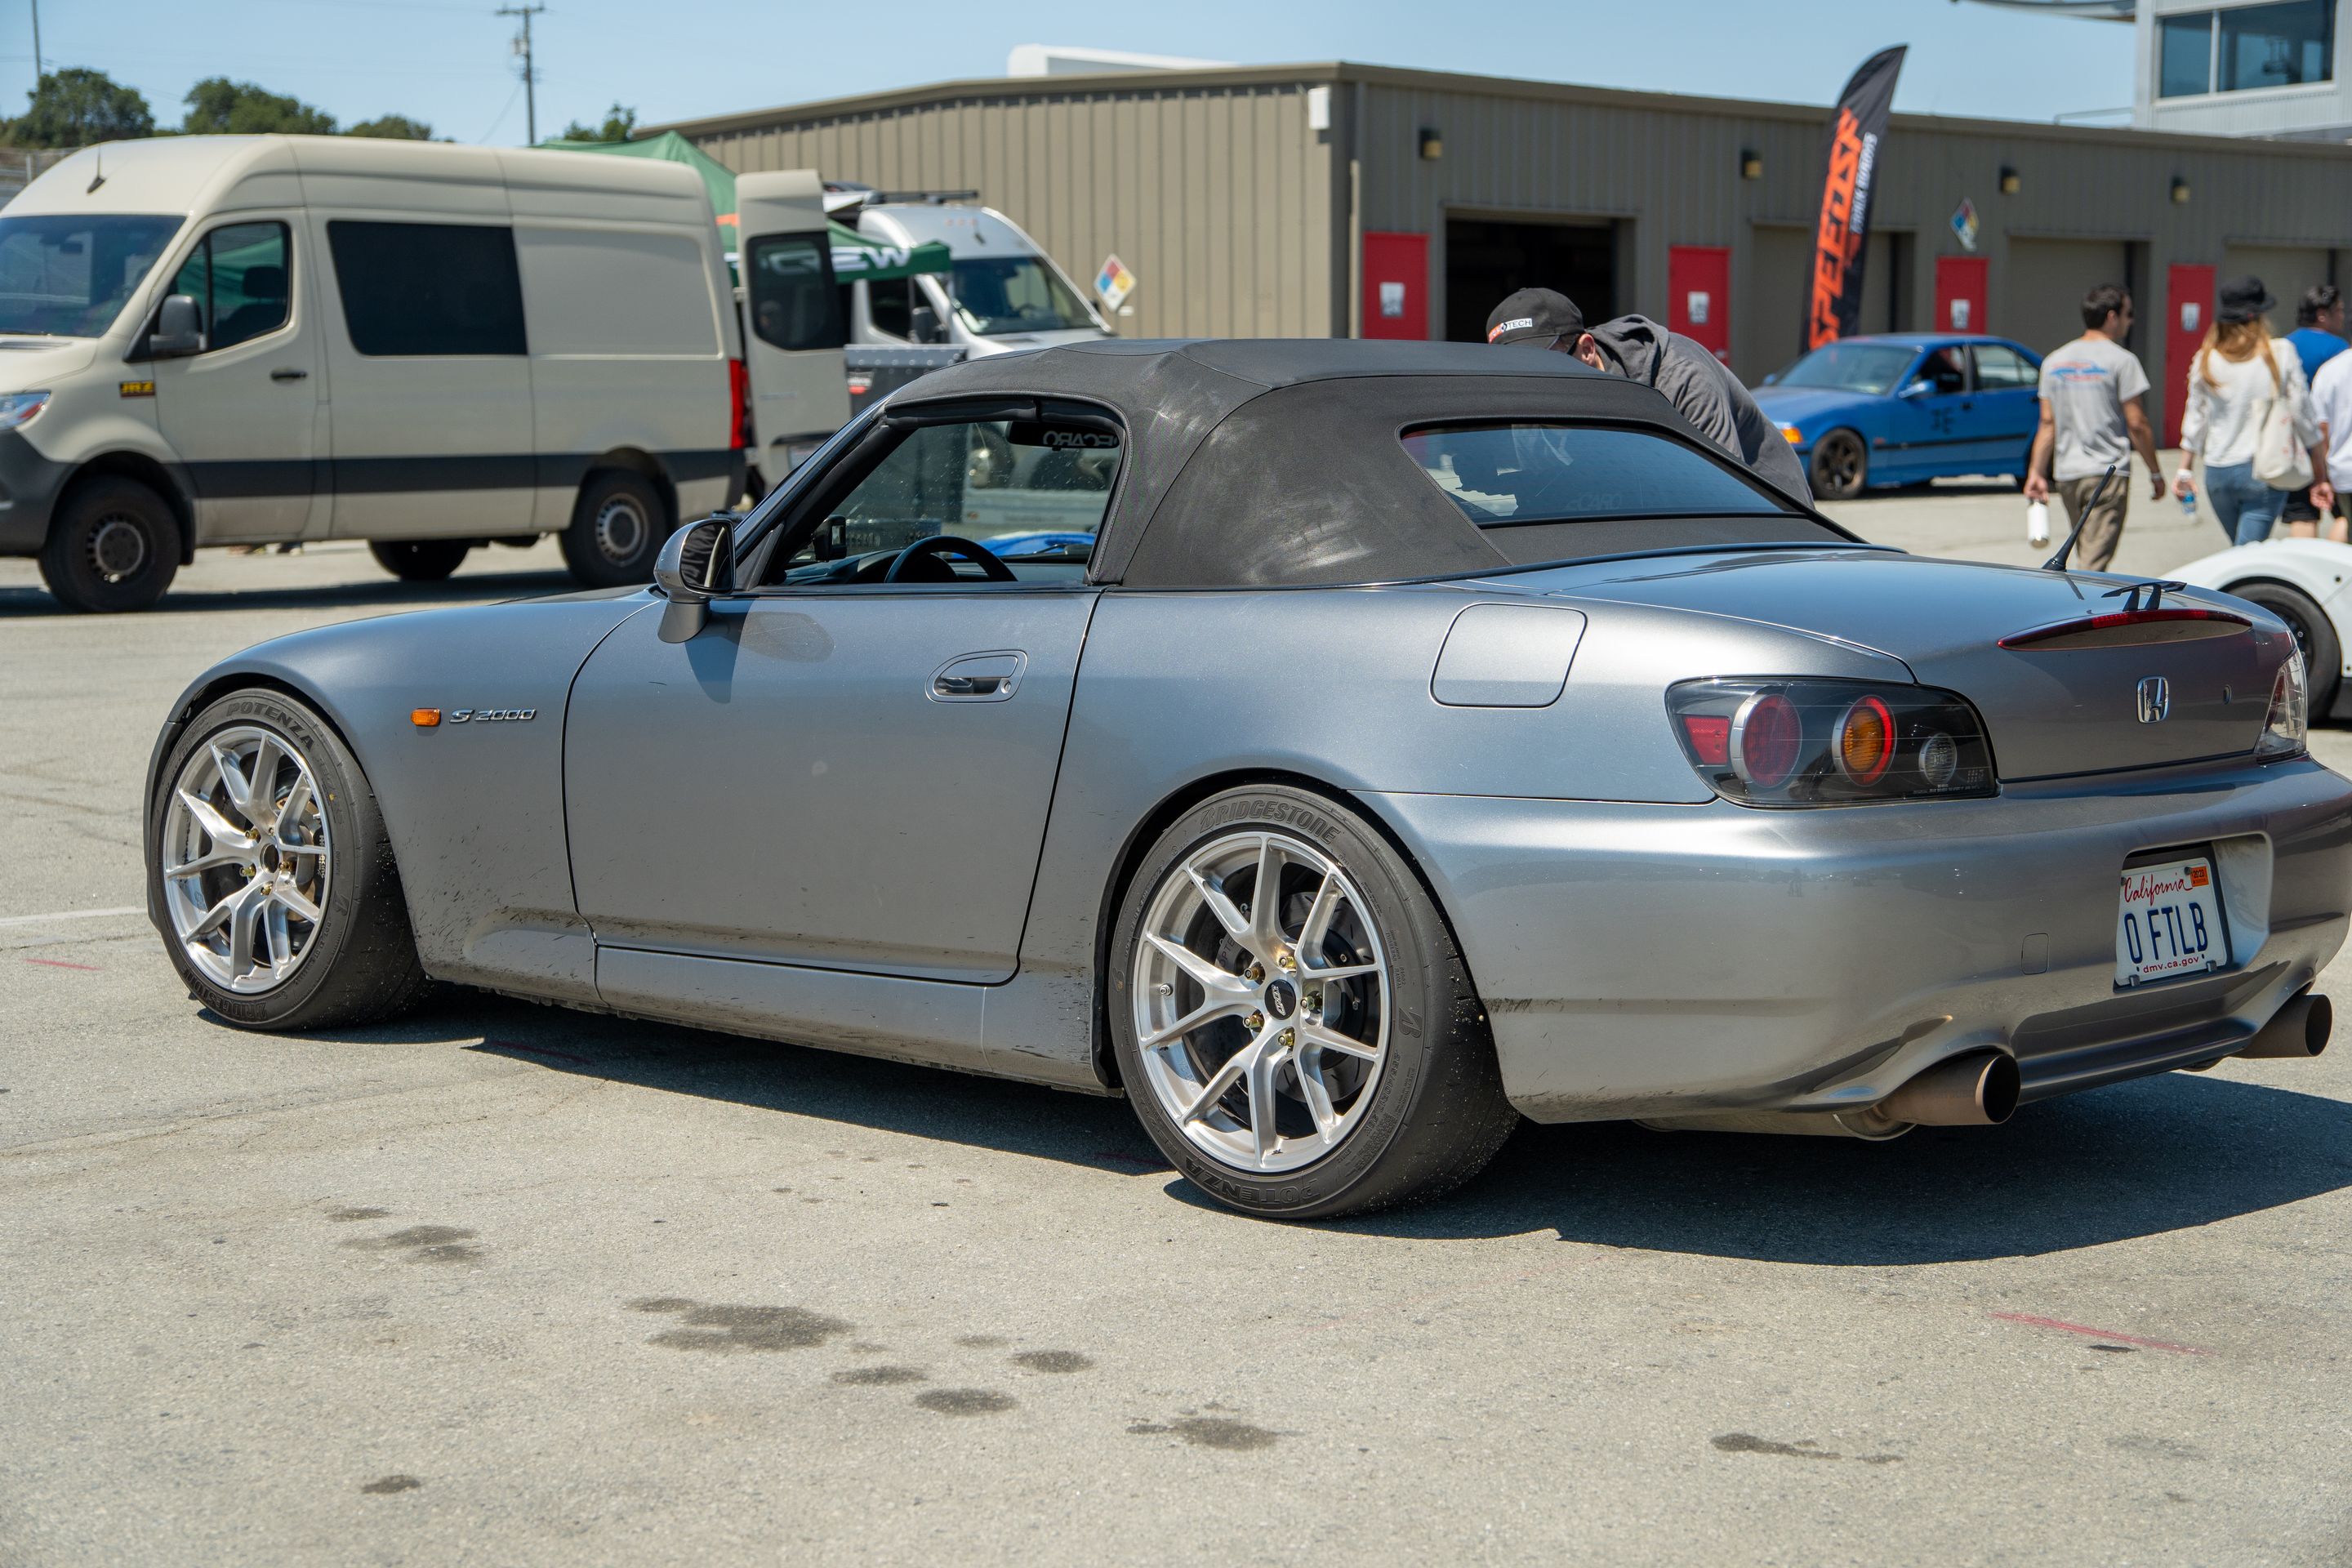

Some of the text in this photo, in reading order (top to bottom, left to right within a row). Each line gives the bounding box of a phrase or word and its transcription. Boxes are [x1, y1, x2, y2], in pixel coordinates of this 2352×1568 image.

[1808, 107, 1863, 351] SPEEDSF
[226, 702, 314, 752] POTENZA
[1200, 800, 1341, 844] BRIDGESTONE
[2123, 871, 2194, 906] California
[2146, 902, 2208, 960] FTLB
[2143, 956, 2199, 973] dmv.ca.gov
[180, 964, 267, 1021] BRIDGESTONE
[1184, 1156, 1320, 1205] POTENZA
